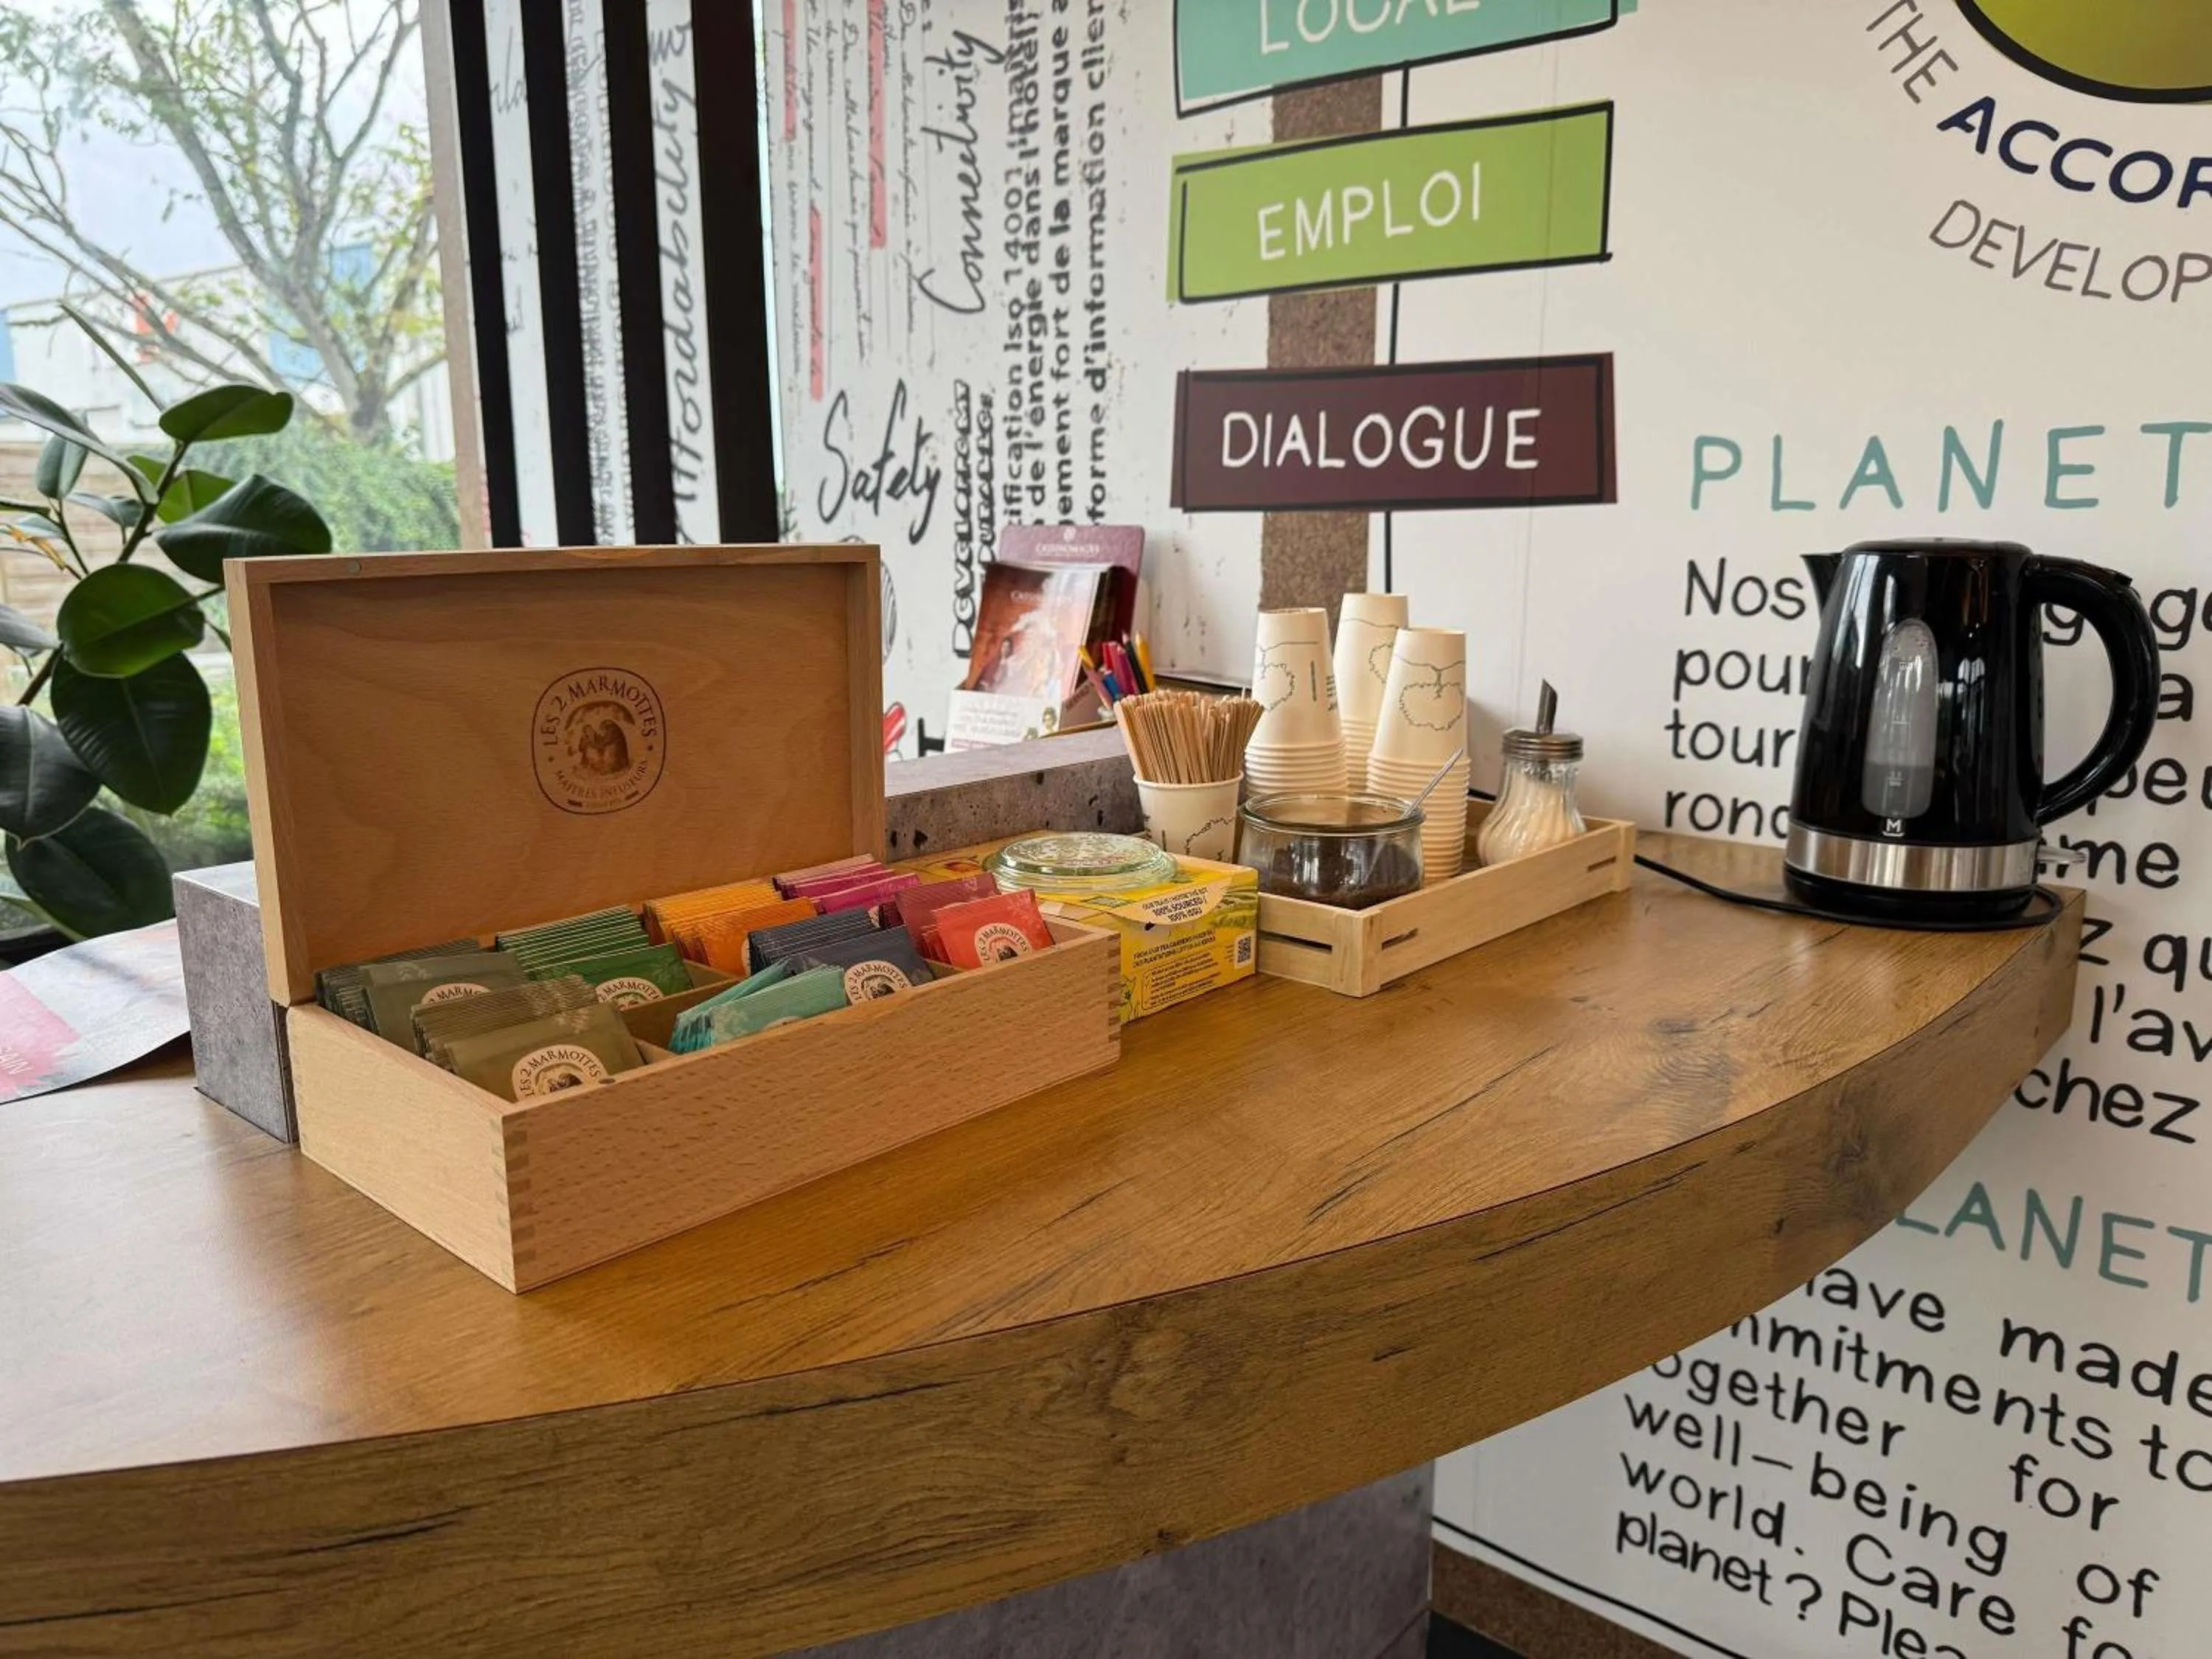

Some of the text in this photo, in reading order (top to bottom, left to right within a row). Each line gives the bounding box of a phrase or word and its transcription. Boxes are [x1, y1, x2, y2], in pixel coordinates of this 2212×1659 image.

[1259, 0, 1480, 54] LOC
[1866, 0, 1959, 103] THE
[1051, 27, 1072, 185] marque
[917, 30, 1004, 314] Connectivity
[1019, 169, 1043, 264] dans
[1048, 199, 1071, 234] la
[1257, 161, 1481, 260] EMPLOI
[1004, 166, 1023, 285] 14001
[1048, 245, 1071, 294] de
[1081, 102, 1107, 392] d'information
[1051, 308, 1071, 379] fort
[818, 378, 941, 545] Safety
[1004, 366, 1023, 526] ification
[1026, 460, 1046, 506] de
[1052, 392, 1074, 526] ement
[1085, 403, 1108, 526] forme
[1222, 406, 1542, 471] DIALOGUE
[1691, 418, 2212, 512] PLANET
[1685, 557, 1806, 619] Nos
[541, 675, 657, 745] LES 2 MARMOTTES
[1664, 708, 1796, 768] tour
[519, 1049, 602, 1097] LES 2 MARMOTTES
[2014, 1057, 2200, 1144] chez
[1652, 1353, 2119, 1531] ogether for
[2140, 1425, 2212, 1492] to
[1617, 1512, 1823, 1621] planet?
[1619, 1453, 1804, 1556] world.
[1846, 1533, 2016, 1636] Care
[2076, 1564, 2159, 1618] of
